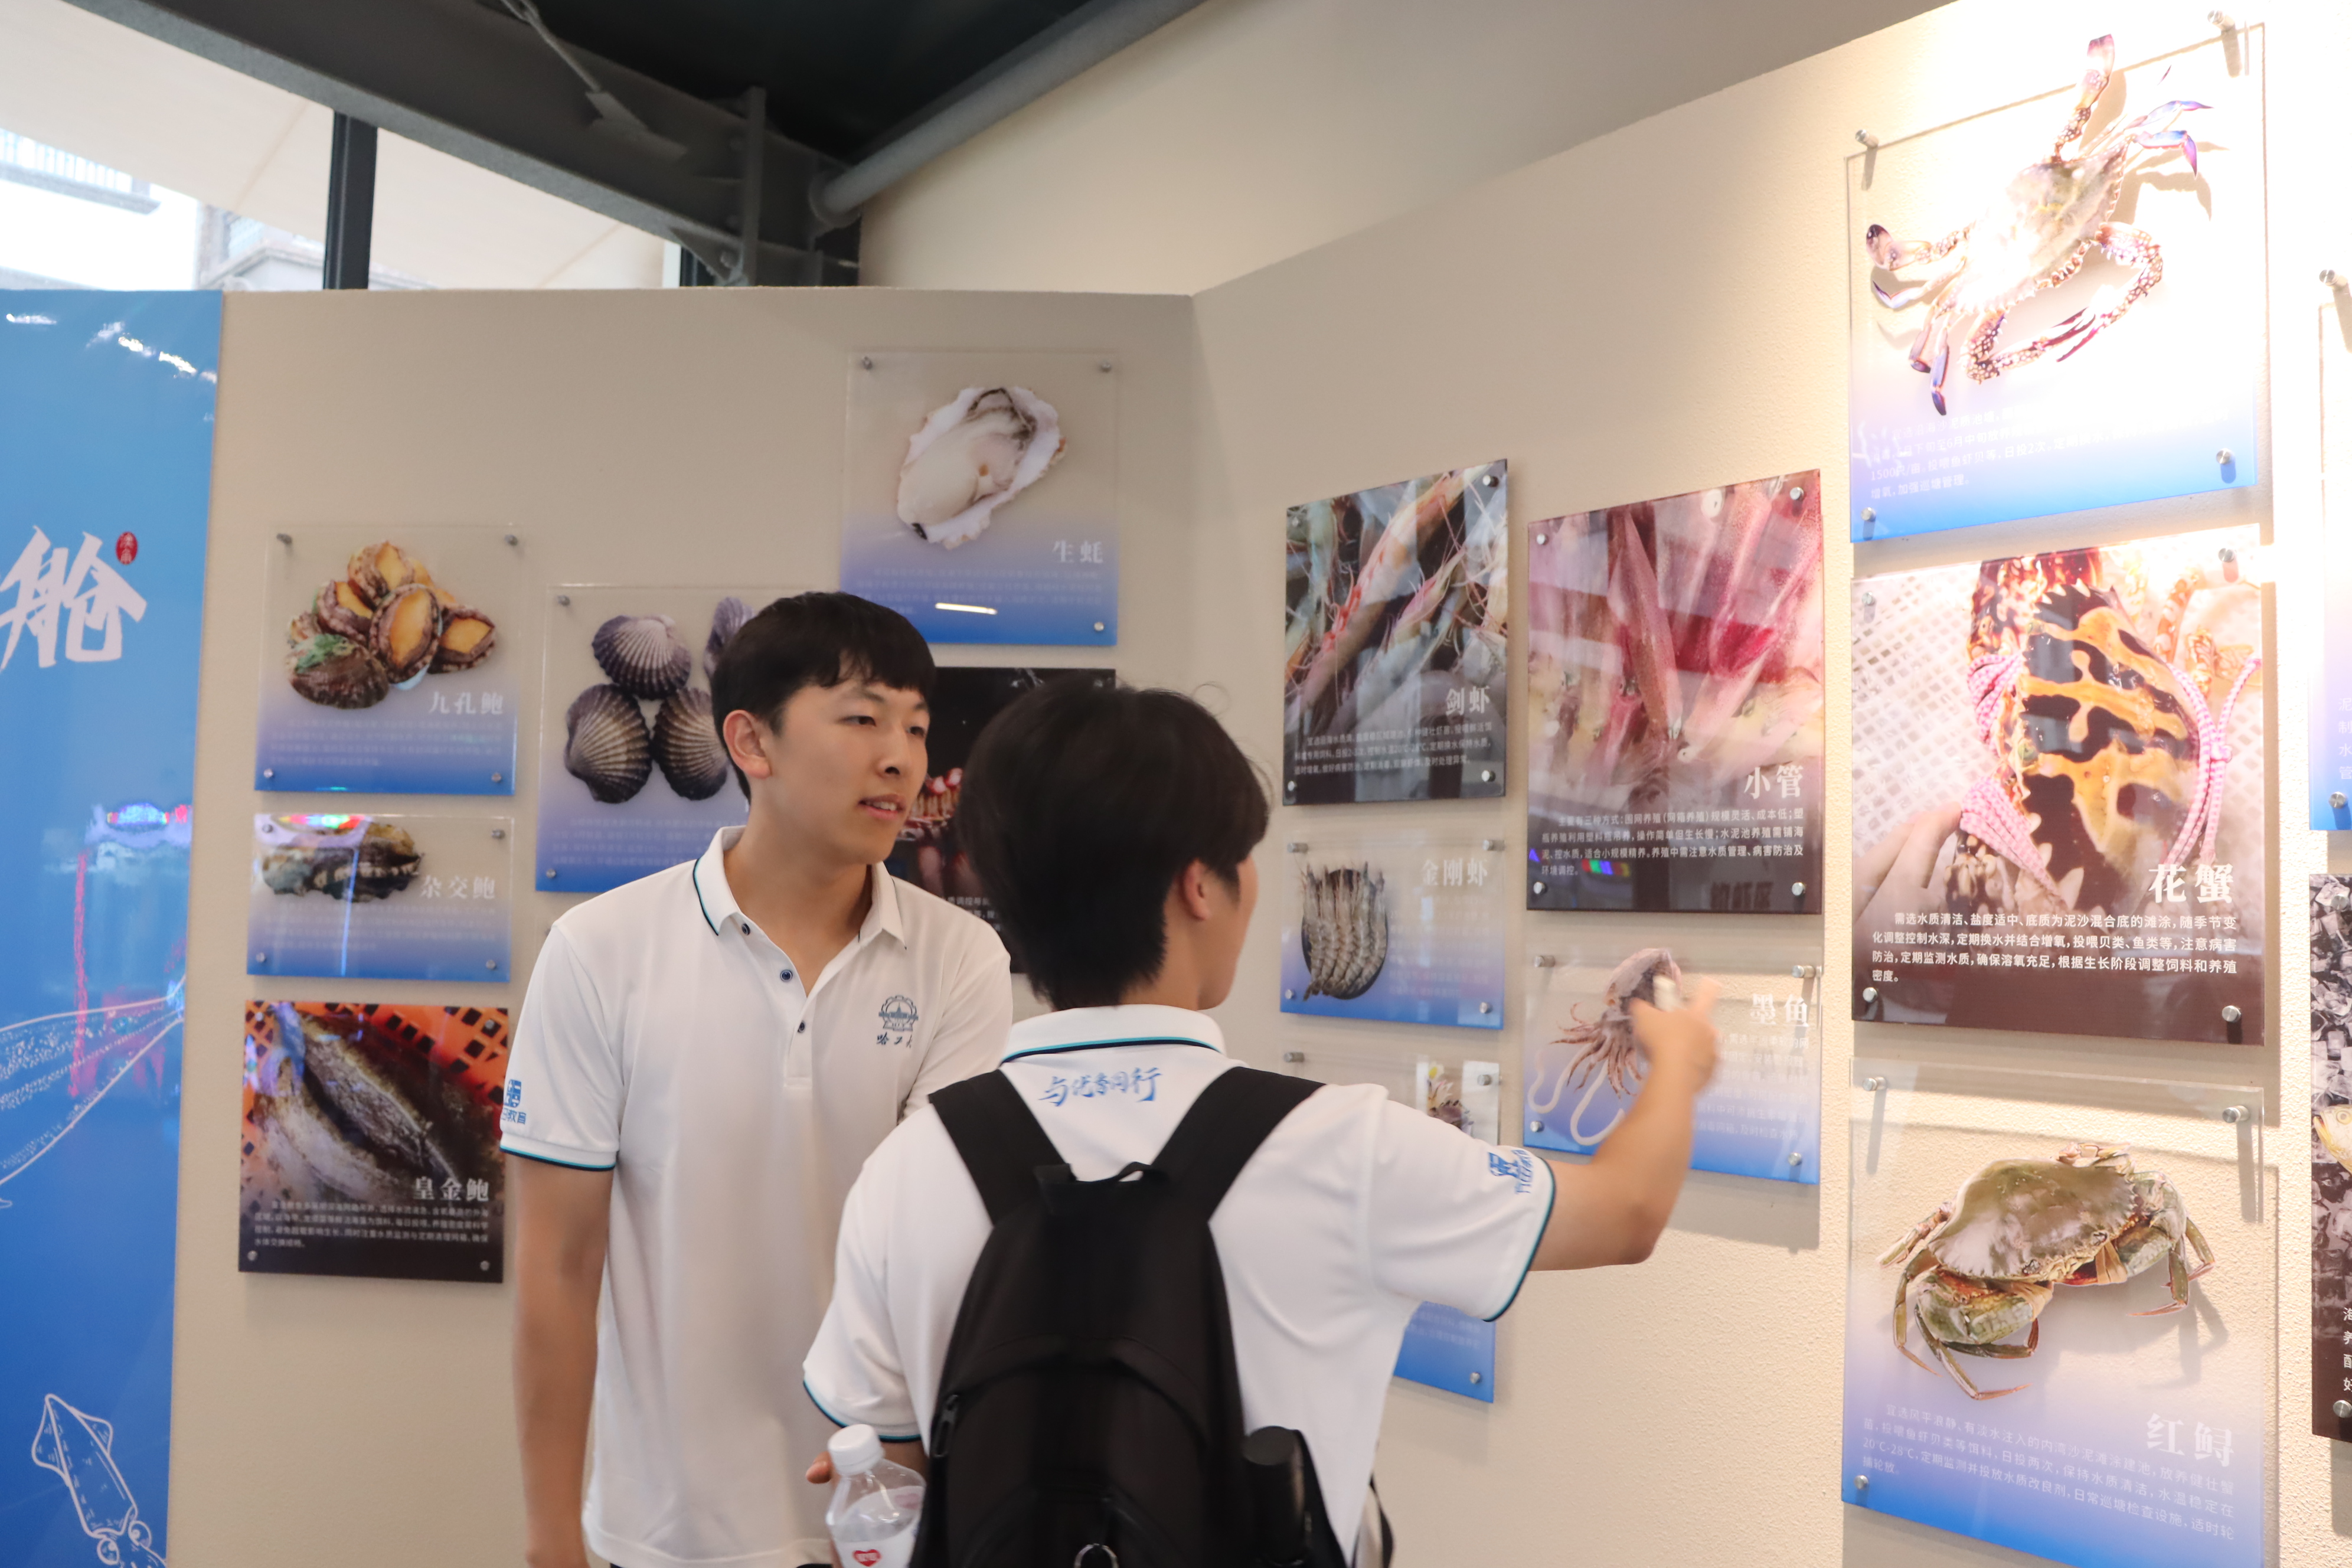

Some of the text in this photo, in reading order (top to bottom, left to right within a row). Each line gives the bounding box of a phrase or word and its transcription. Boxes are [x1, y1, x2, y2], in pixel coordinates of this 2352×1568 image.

[1053, 540, 1103, 563] 生蚝
[428, 692, 503, 715] 九孔鲍
[1445, 685, 1491, 716] 剑虾
[1744, 765, 1804, 799] 小管
[1422, 858, 1489, 886] 金刚虾
[2148, 863, 2234, 904] 花蟹
[421, 875, 496, 900] 杂交鲍
[1895, 913, 2237, 930] 需选水质清洁、盐度适中、底质为泥沙混合底的滩涂，随季节变
[1873, 932, 2237, 952] 化调整控制水深，定期换水并结合增氧，投喂贝类、鱼类等，注意病害
[1873, 950, 2237, 974] 防治，定期监测水质，确保溶氧充足，根据生长阶段调整饲料和养殖
[1873, 970, 1899, 982] 密度。
[1749, 994, 1809, 1027] 墨鱼
[414, 1176, 489, 1202] 皇金鲍
[2147, 1413, 2235, 1468] 红鲟
